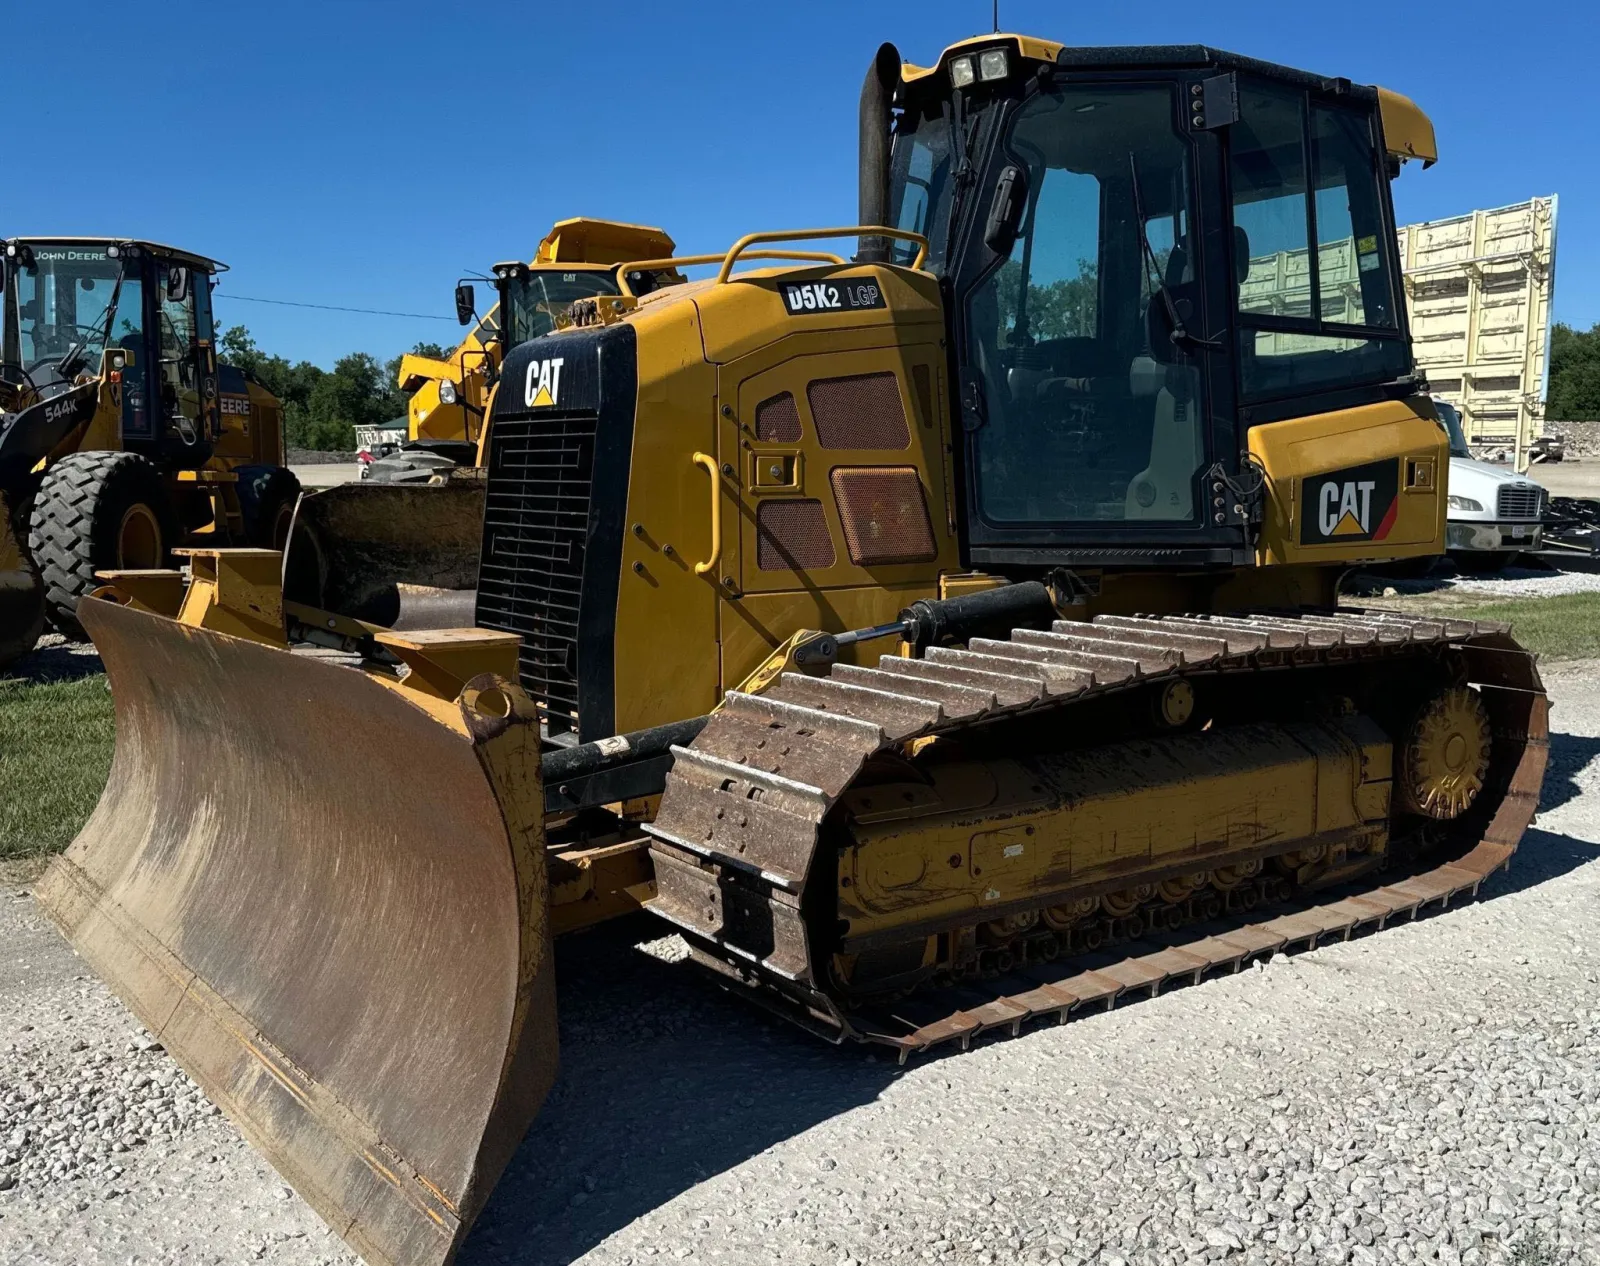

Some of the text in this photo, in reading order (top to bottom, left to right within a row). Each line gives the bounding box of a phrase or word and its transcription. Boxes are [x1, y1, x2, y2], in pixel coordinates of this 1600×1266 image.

[34, 251, 106, 260] JOHN DEERE
[563, 273, 577, 282] CAT
[786, 284, 878, 310] D5K2 LGP
[525, 358, 564, 407] CAT
[45, 398, 78, 423] 544K
[220, 398, 250, 415] EERE
[1318, 481, 1376, 536] CAT
